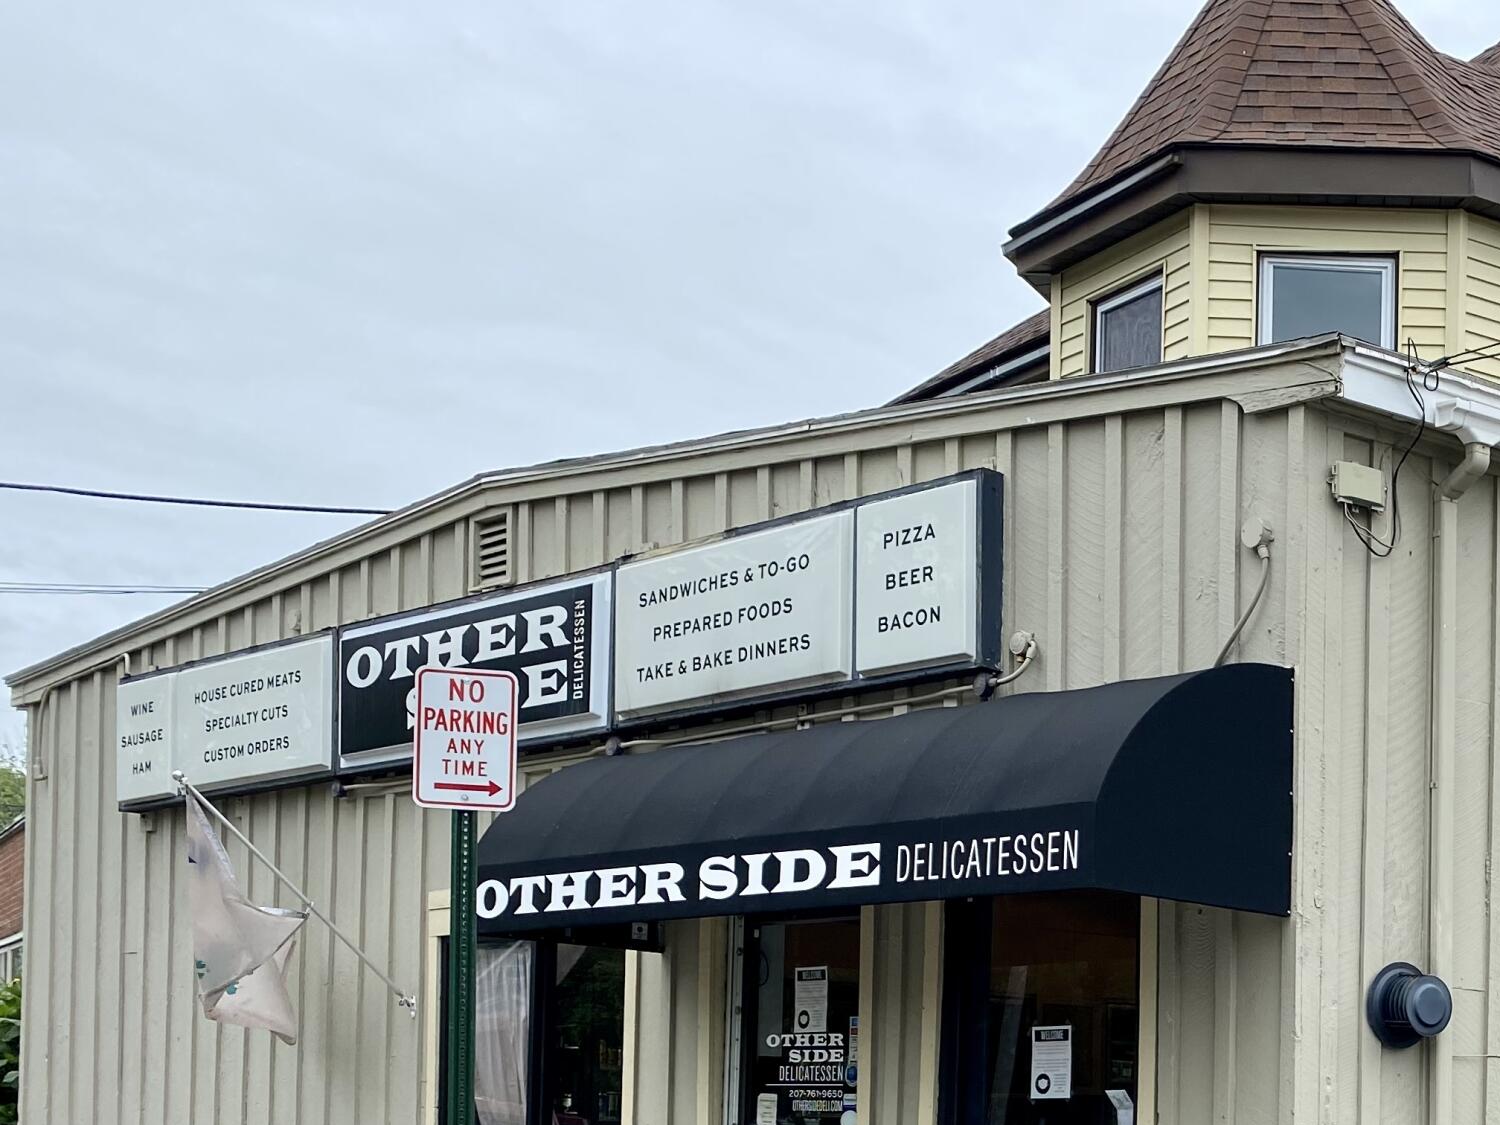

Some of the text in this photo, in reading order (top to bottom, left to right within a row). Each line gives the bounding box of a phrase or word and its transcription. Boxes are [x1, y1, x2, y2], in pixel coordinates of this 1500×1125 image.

[882, 523, 936, 550] PIZZA
[638, 553, 810, 608] SANDWICHES & TO-GO
[885, 565, 934, 590] BEER
[653, 597, 793, 642] PREPARED FOODS
[877, 606, 942, 633] BACON
[346, 605, 572, 689] OTHER
[572, 599, 585, 700] DELICATESSEN
[636, 633, 811, 683] TAKE & BAKE DINNERS
[194, 670, 302, 705] HOUSE CURED MEATS
[448, 678, 485, 704] NO
[130, 701, 154, 717] WINE
[205, 705, 288, 732] SPECIALTY CUTS
[423, 707, 508, 735] PARKING
[121, 729, 163, 748] SAUSAGE
[203, 736, 290, 763] CUSTOM ORDERS
[447, 739, 485, 755] ANY
[132, 761, 152, 775] HAM
[442, 759, 488, 777] TIME
[476, 829, 1080, 920] OTHER SIDE DELICATESSEN
[766, 1033, 844, 1047] OTHER
[789, 1049, 844, 1063] SIDE
[779, 1065, 843, 1082] DELICATESSEN
